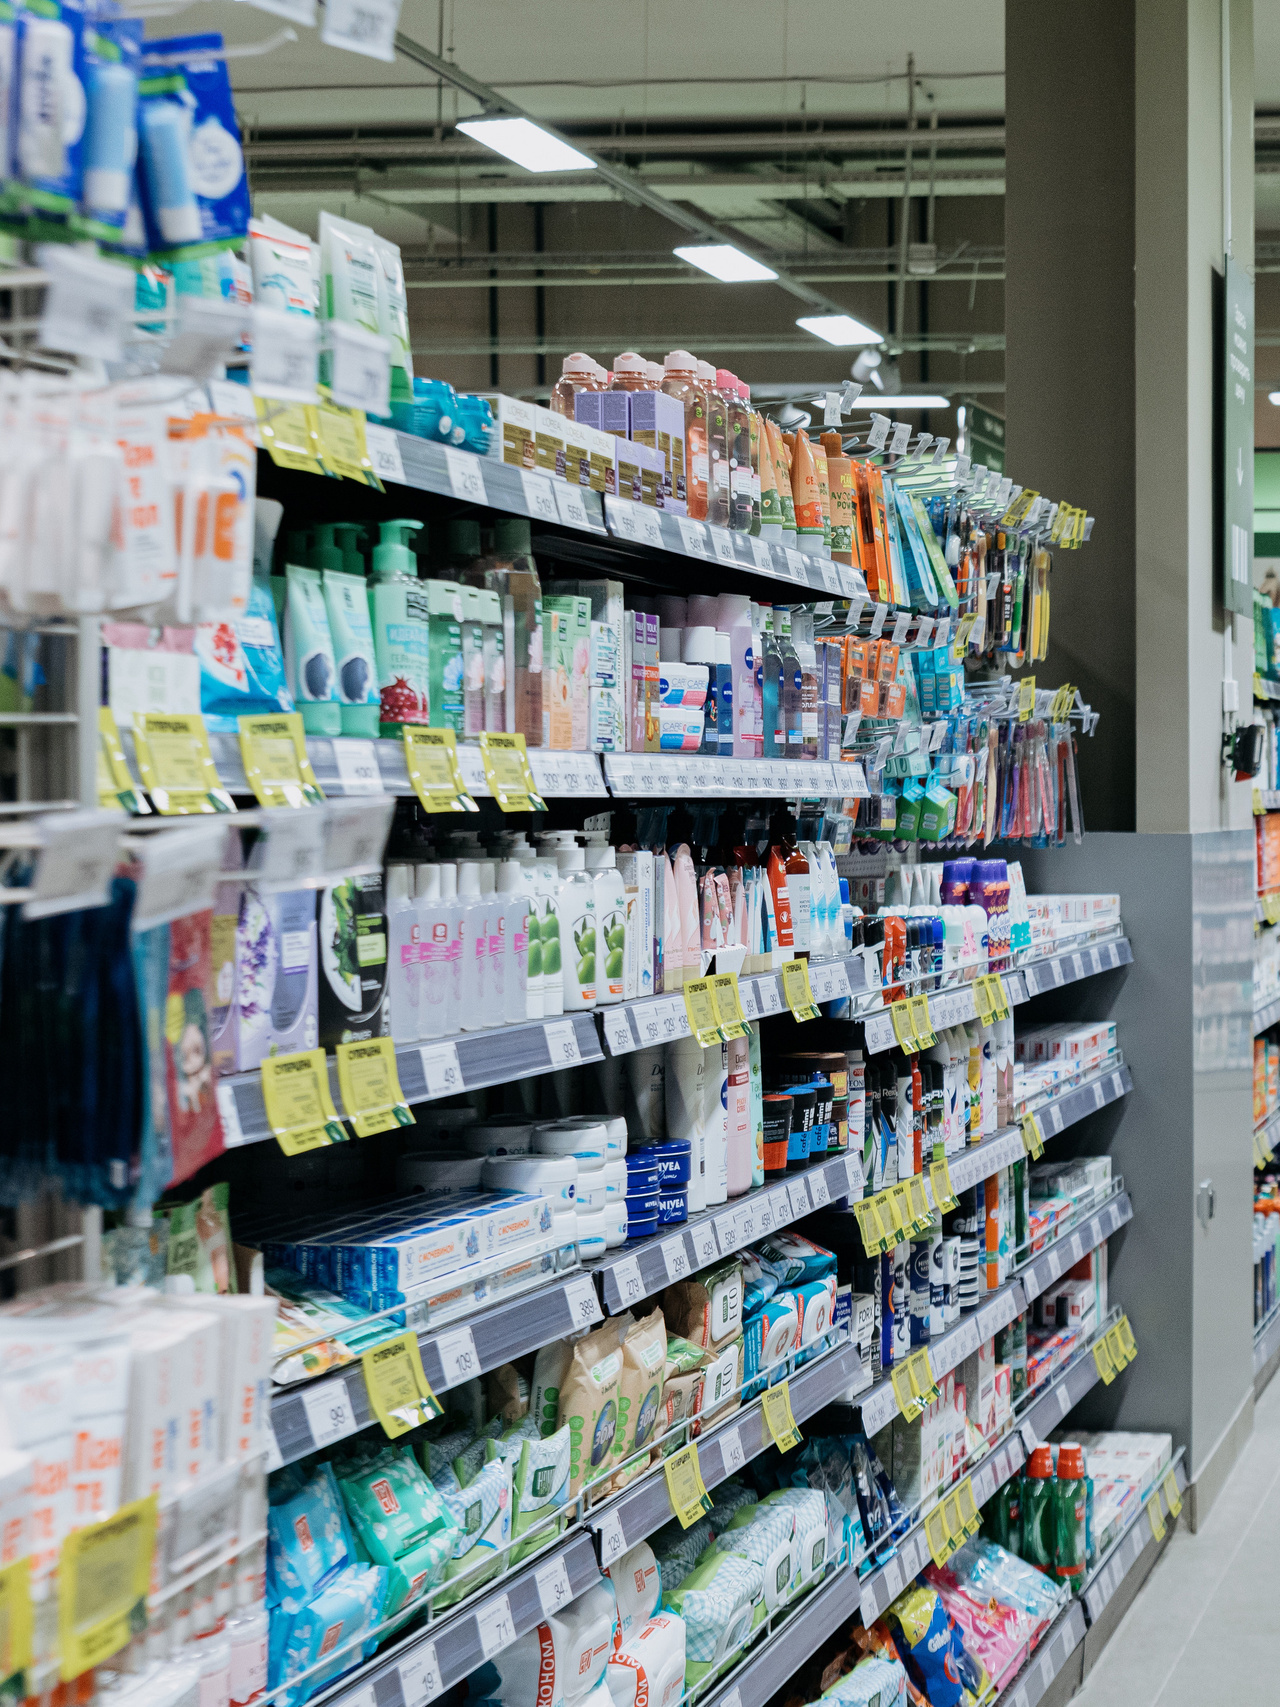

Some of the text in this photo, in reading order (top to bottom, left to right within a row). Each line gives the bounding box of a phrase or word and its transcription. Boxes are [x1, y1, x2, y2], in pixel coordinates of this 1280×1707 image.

[563, 1042, 575, 1058] 93
[659, 1198, 685, 1211] NIVEA
[503, 1216, 530, 1233] МОЧЕВИНОЙ
[423, 1241, 455, 1261] МОЧЕВИНОЙ
[626, 1278, 640, 1296] 279
[579, 1299, 595, 1317] 389
[729, 1287, 738, 1321] ECO
[455, 1351, 472, 1371] 109
[722, 1363, 734, 1397] ECO
[671, 1452, 691, 1471] СУПЕРЦЕНА
[607, 1533, 622, 1551] 129
[554, 1582, 566, 1600] 34
[421, 1672, 435, 1691] 19
